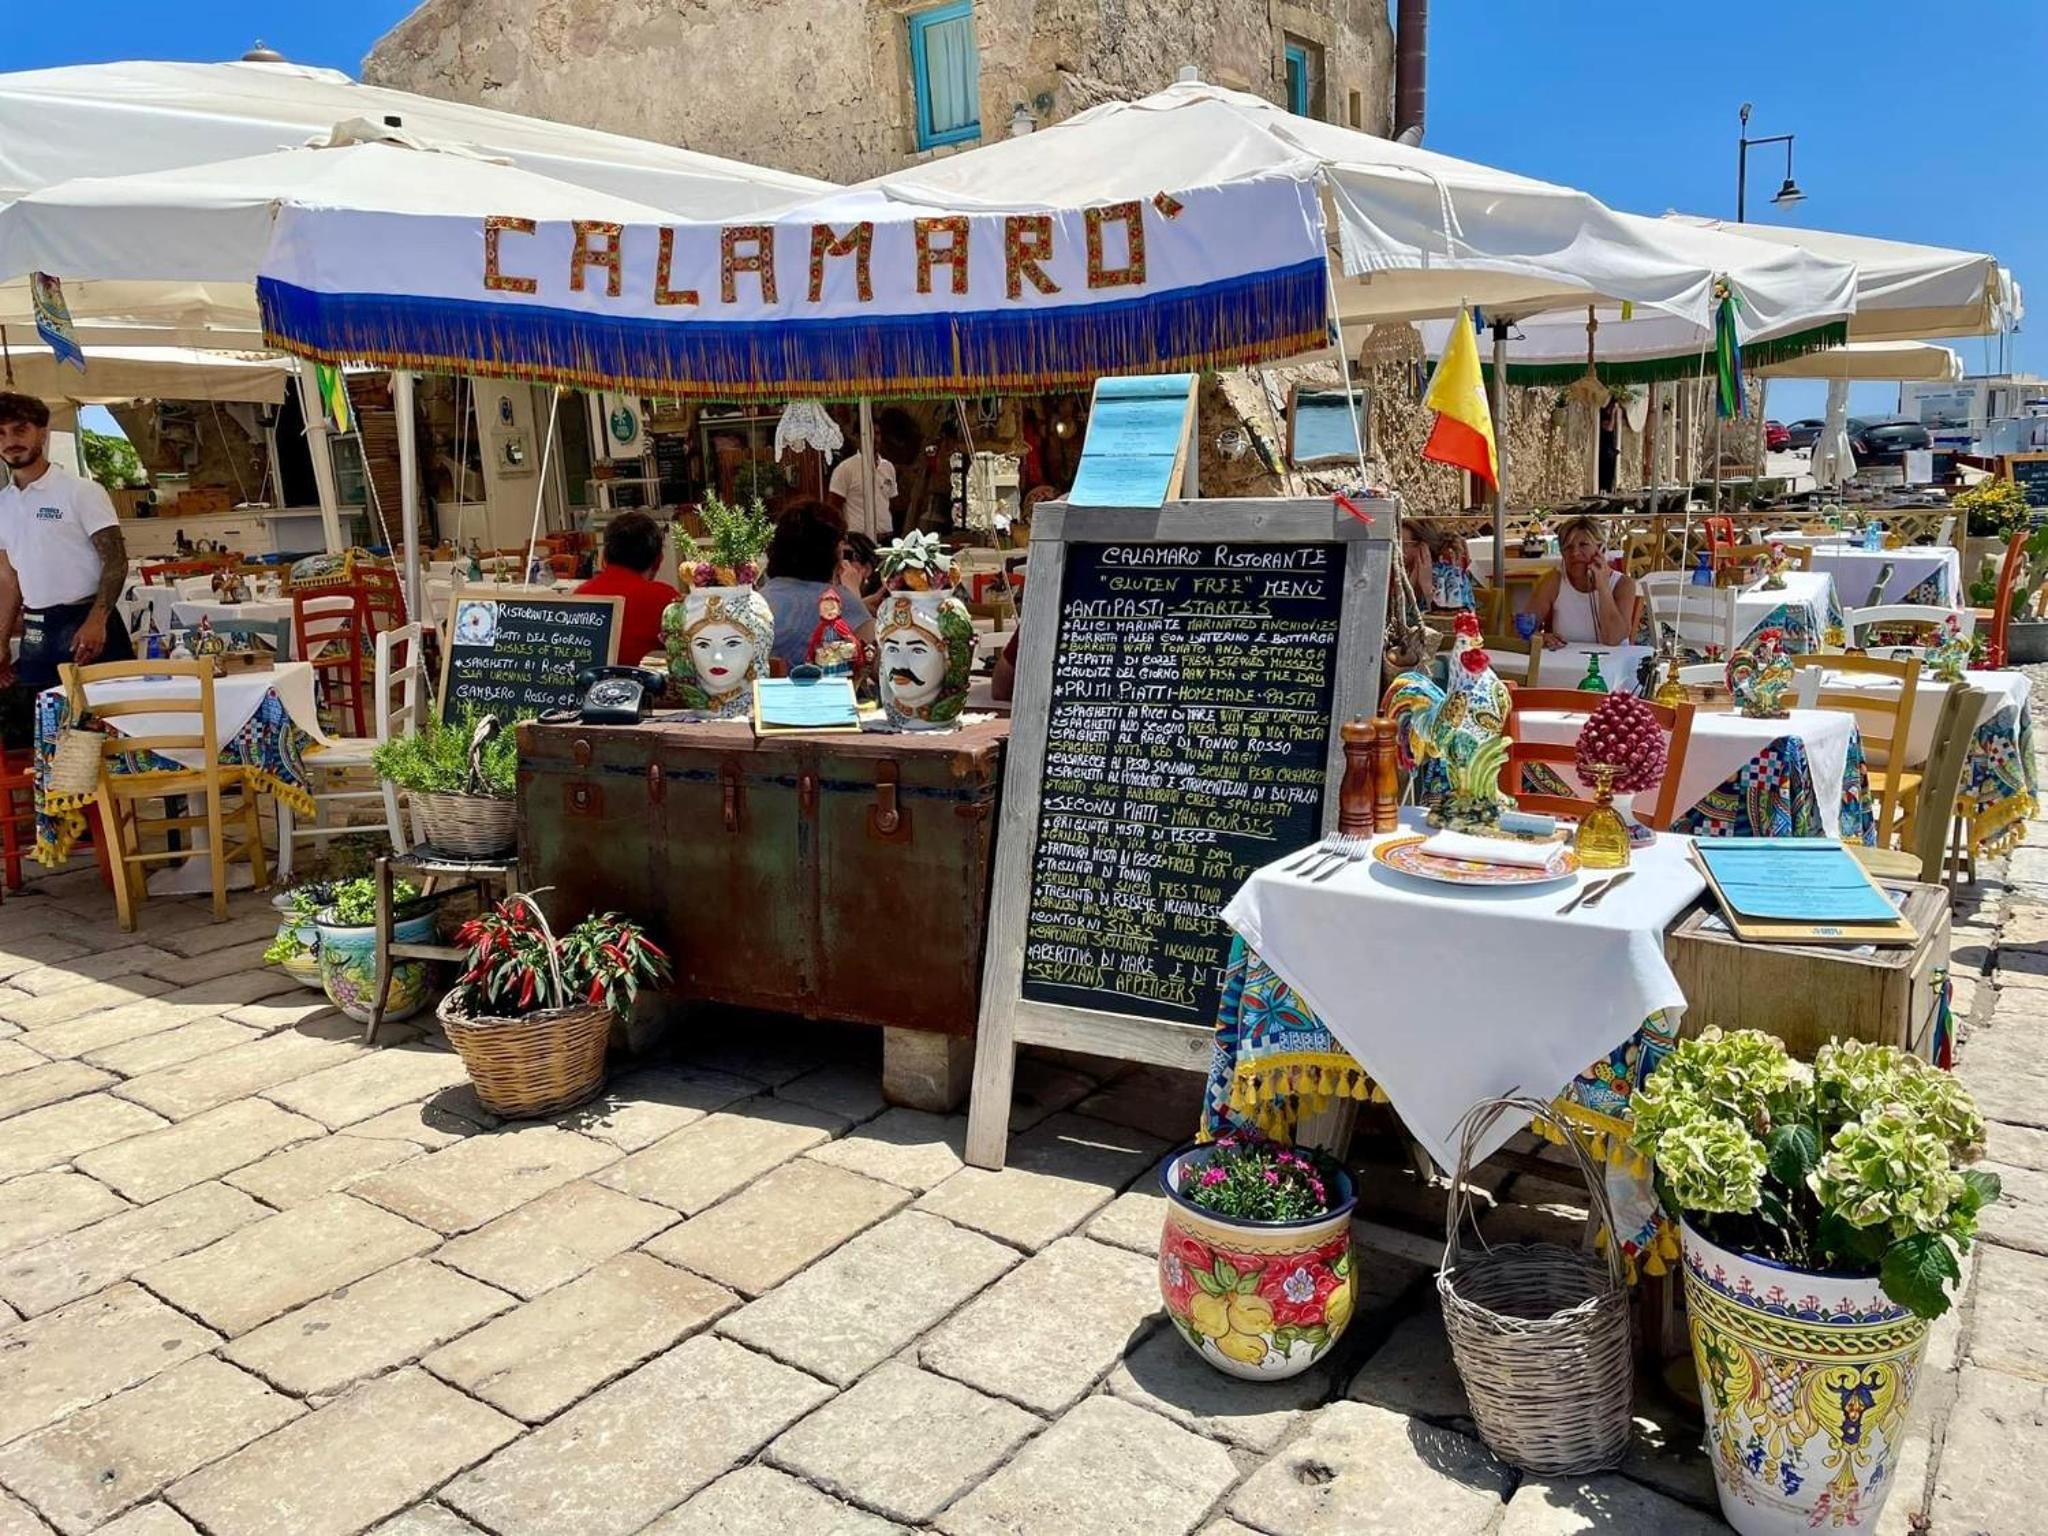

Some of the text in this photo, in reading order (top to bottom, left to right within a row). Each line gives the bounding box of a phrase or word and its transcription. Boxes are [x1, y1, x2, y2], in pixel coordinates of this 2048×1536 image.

[1214, 545, 1328, 569] RISTORANTE
[499, 603, 554, 623] RISTORANTE
[1071, 598, 1164, 617] ANTIPASTI
[1116, 619, 1181, 631] MARINATE
[1187, 618, 1257, 631] MARINATED
[526, 632, 548, 643] DEL
[550, 632, 592, 647] GIORNO
[1215, 643, 1243, 655] AND
[1197, 735, 1240, 750] TONNO
[1247, 738, 1292, 755] ROSSO
